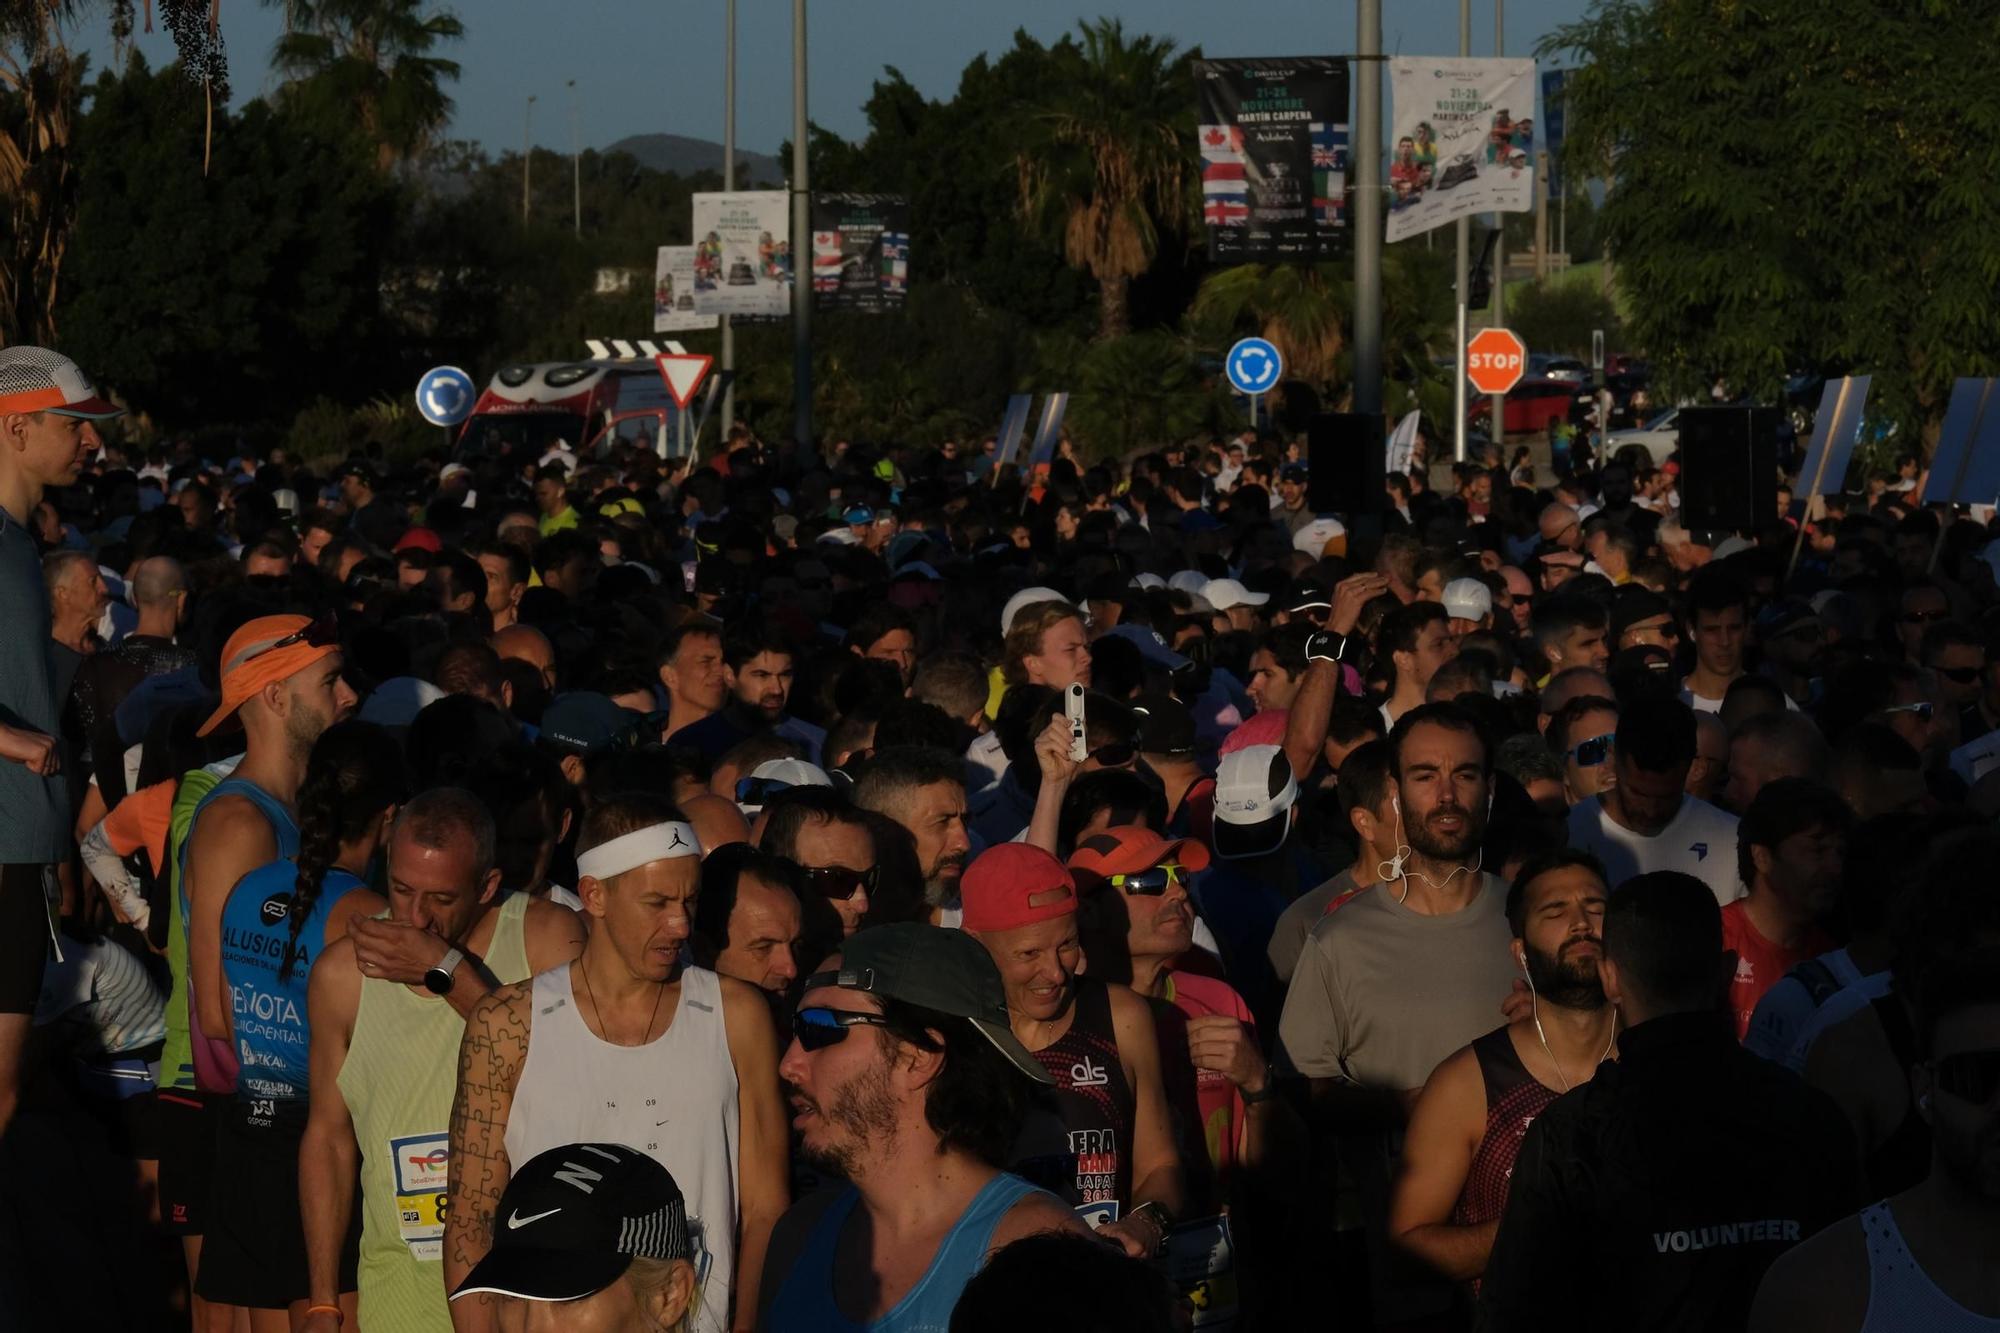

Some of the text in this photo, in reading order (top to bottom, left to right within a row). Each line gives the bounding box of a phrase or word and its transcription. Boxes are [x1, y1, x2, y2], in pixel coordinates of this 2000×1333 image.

[1241, 98, 1304, 111] NOVIEMBRE
[1273, 110, 1312, 121] CARPENA
[1470, 353, 1520, 370] STOP
[552, 1144, 640, 1194] NI
[1652, 1219, 1801, 1253] VOLUNTEER
